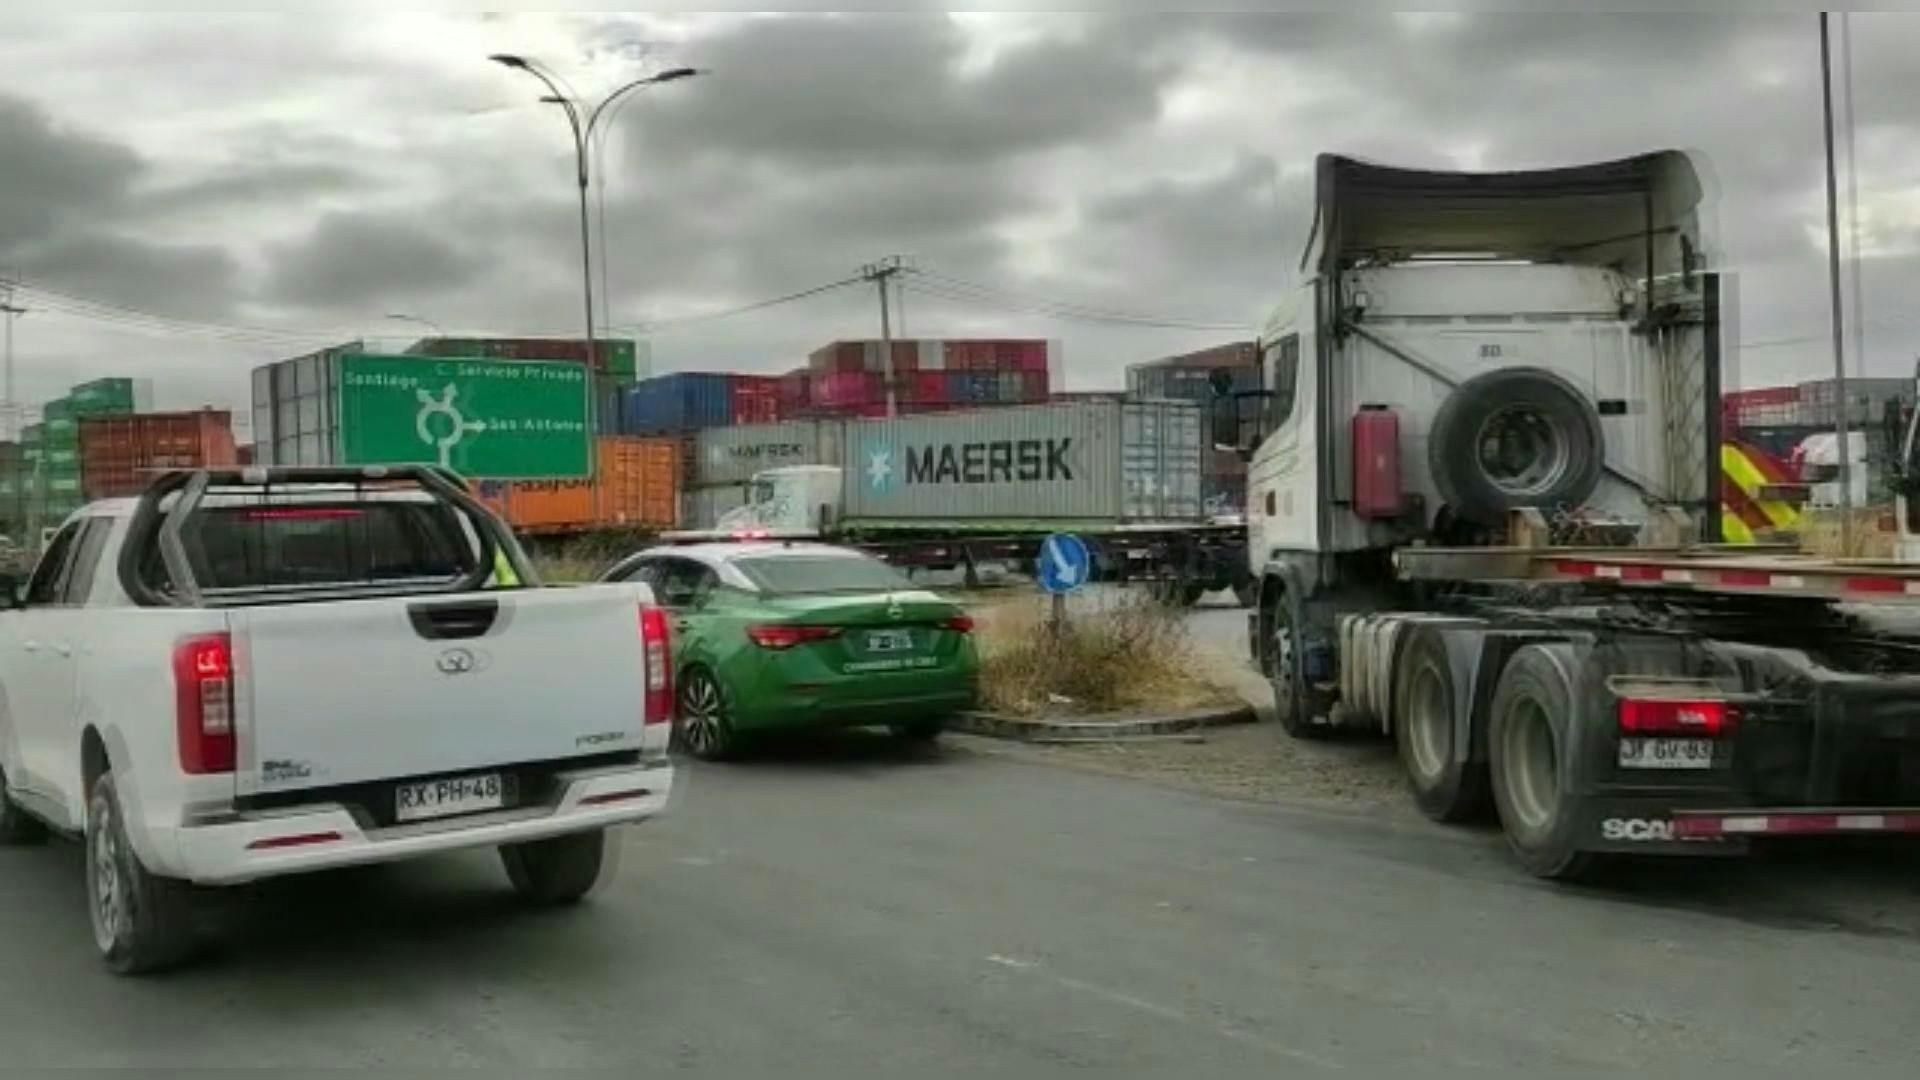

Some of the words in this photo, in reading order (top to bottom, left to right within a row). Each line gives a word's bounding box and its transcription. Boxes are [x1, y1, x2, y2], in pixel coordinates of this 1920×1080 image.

[458, 362, 520, 379] Servicio
[344, 371, 419, 391] Santiago
[904, 437, 1074, 484] MAERSK
